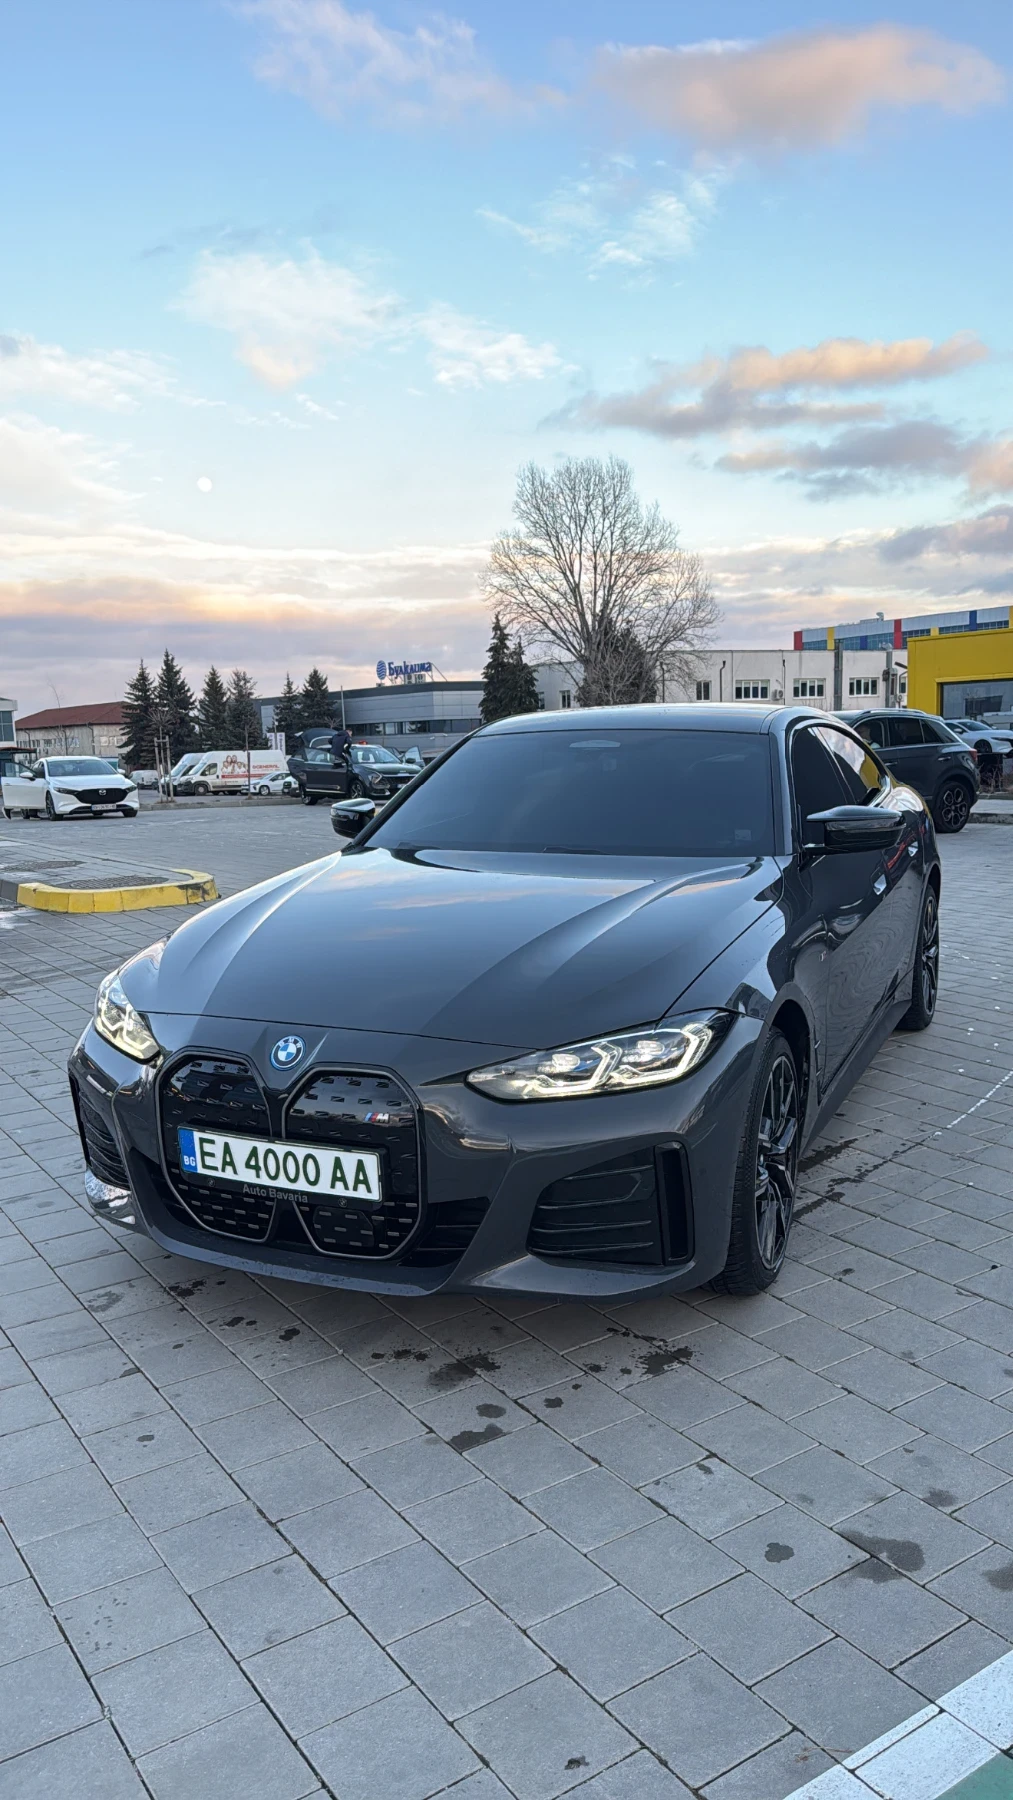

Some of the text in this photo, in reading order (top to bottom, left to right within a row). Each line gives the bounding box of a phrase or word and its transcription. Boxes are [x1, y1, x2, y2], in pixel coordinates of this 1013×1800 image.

[183, 1155, 196, 1167] BG
[199, 1137, 372, 1194] EA 4000 AA
[243, 1184, 309, 1204] Auto Bavaria
